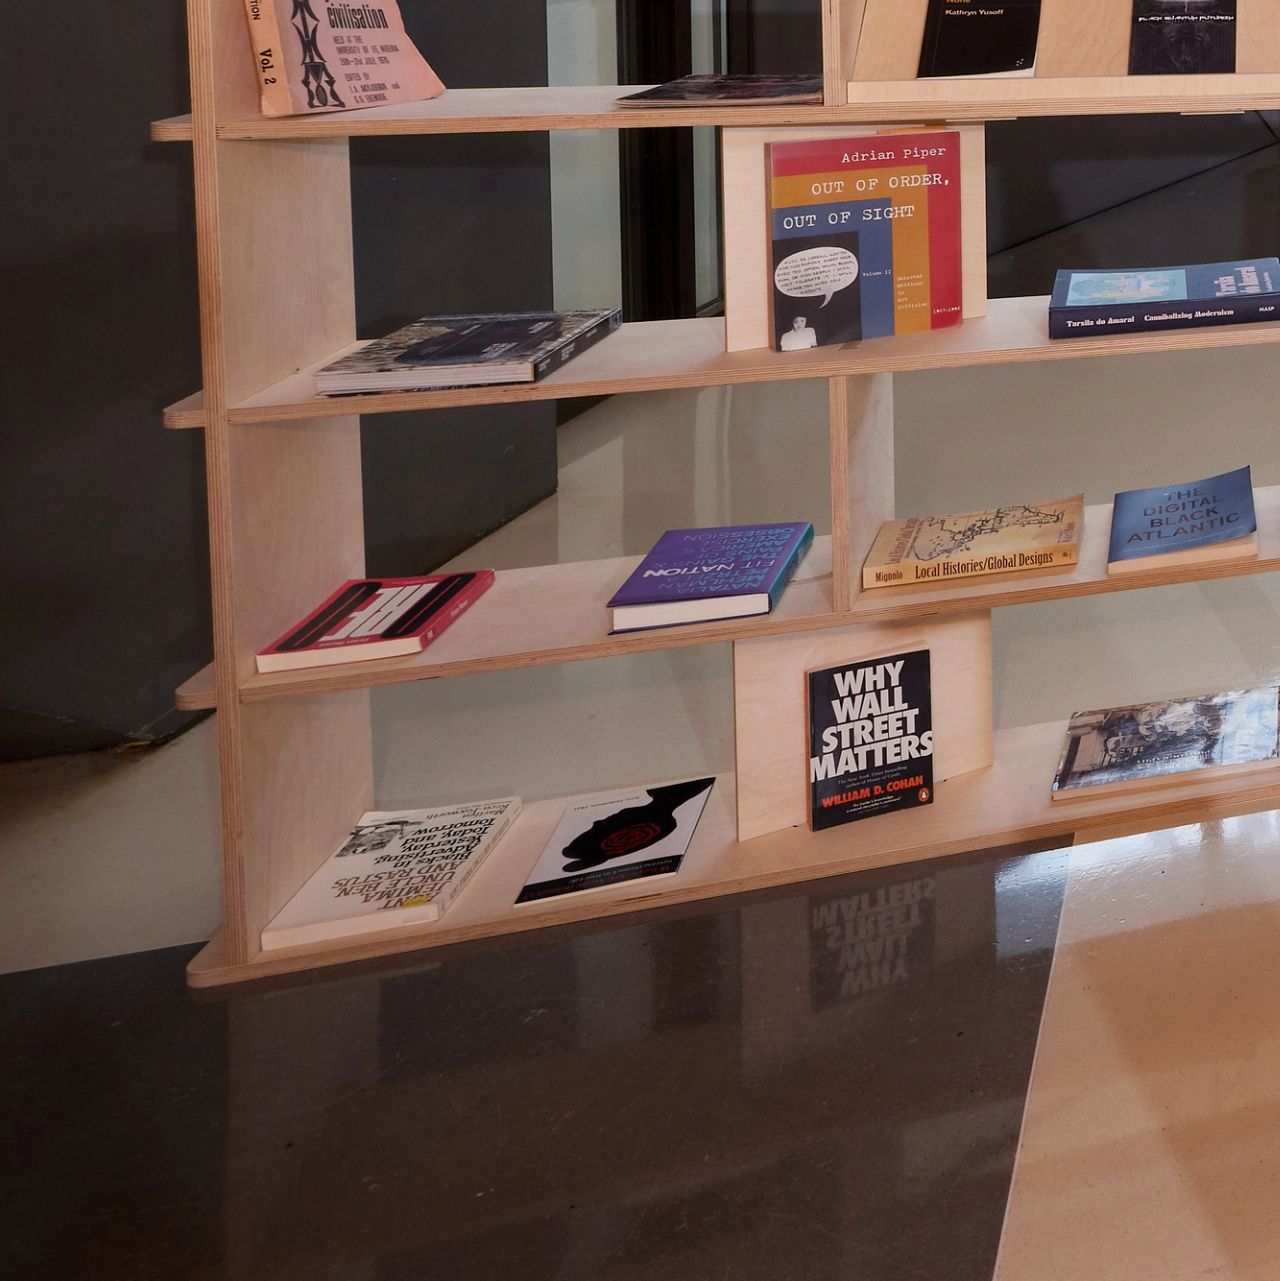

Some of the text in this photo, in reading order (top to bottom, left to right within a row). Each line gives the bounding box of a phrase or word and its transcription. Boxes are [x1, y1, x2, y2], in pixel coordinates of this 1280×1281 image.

[326, 2, 389, 29] civilisation
[945, 8, 1004, 17] Kathryn Yusoff
[264, 77, 277, 85] 2
[841, 147, 946, 164] Adrian Piper
[811, 173, 950, 196] OUT OF ORDER,
[783, 205, 915, 230] OUT OF SIGHT
[1066, 318, 1095, 328] Tarsila
[1095, 318, 1106, 326] do
[1107, 315, 1135, 325] Amaral
[1144, 310, 1193, 322] Cannibalizing
[1194, 308, 1234, 318] Modernism
[1165, 486, 1207, 502] THE
[1142, 495, 1226, 517] DIGITAL
[1125, 512, 1241, 543] ATLANTIC
[1149, 506, 1221, 530] BLACK
[640, 558, 776, 578] FIT NATION
[875, 570, 903, 585] Mignolo
[914, 552, 1054, 581] Local Histories/Global Designs
[673, 580, 762, 594] NATALIA
[833, 660, 905, 698] WHY
[831, 686, 909, 724] WALL
[822, 708, 920, 754] STREET
[810, 730, 933, 783] MATTERS
[822, 786, 871, 808] WILLIAM
[873, 784, 885, 796] D.
[886, 775, 924, 792] COHAN
[411, 817, 497, 837] Tomorrow
[400, 836, 438, 847] and
[392, 850, 473, 869] Blacks in
[330, 860, 465, 889] AND RASTUS
[387, 870, 457, 889] UNCLE
